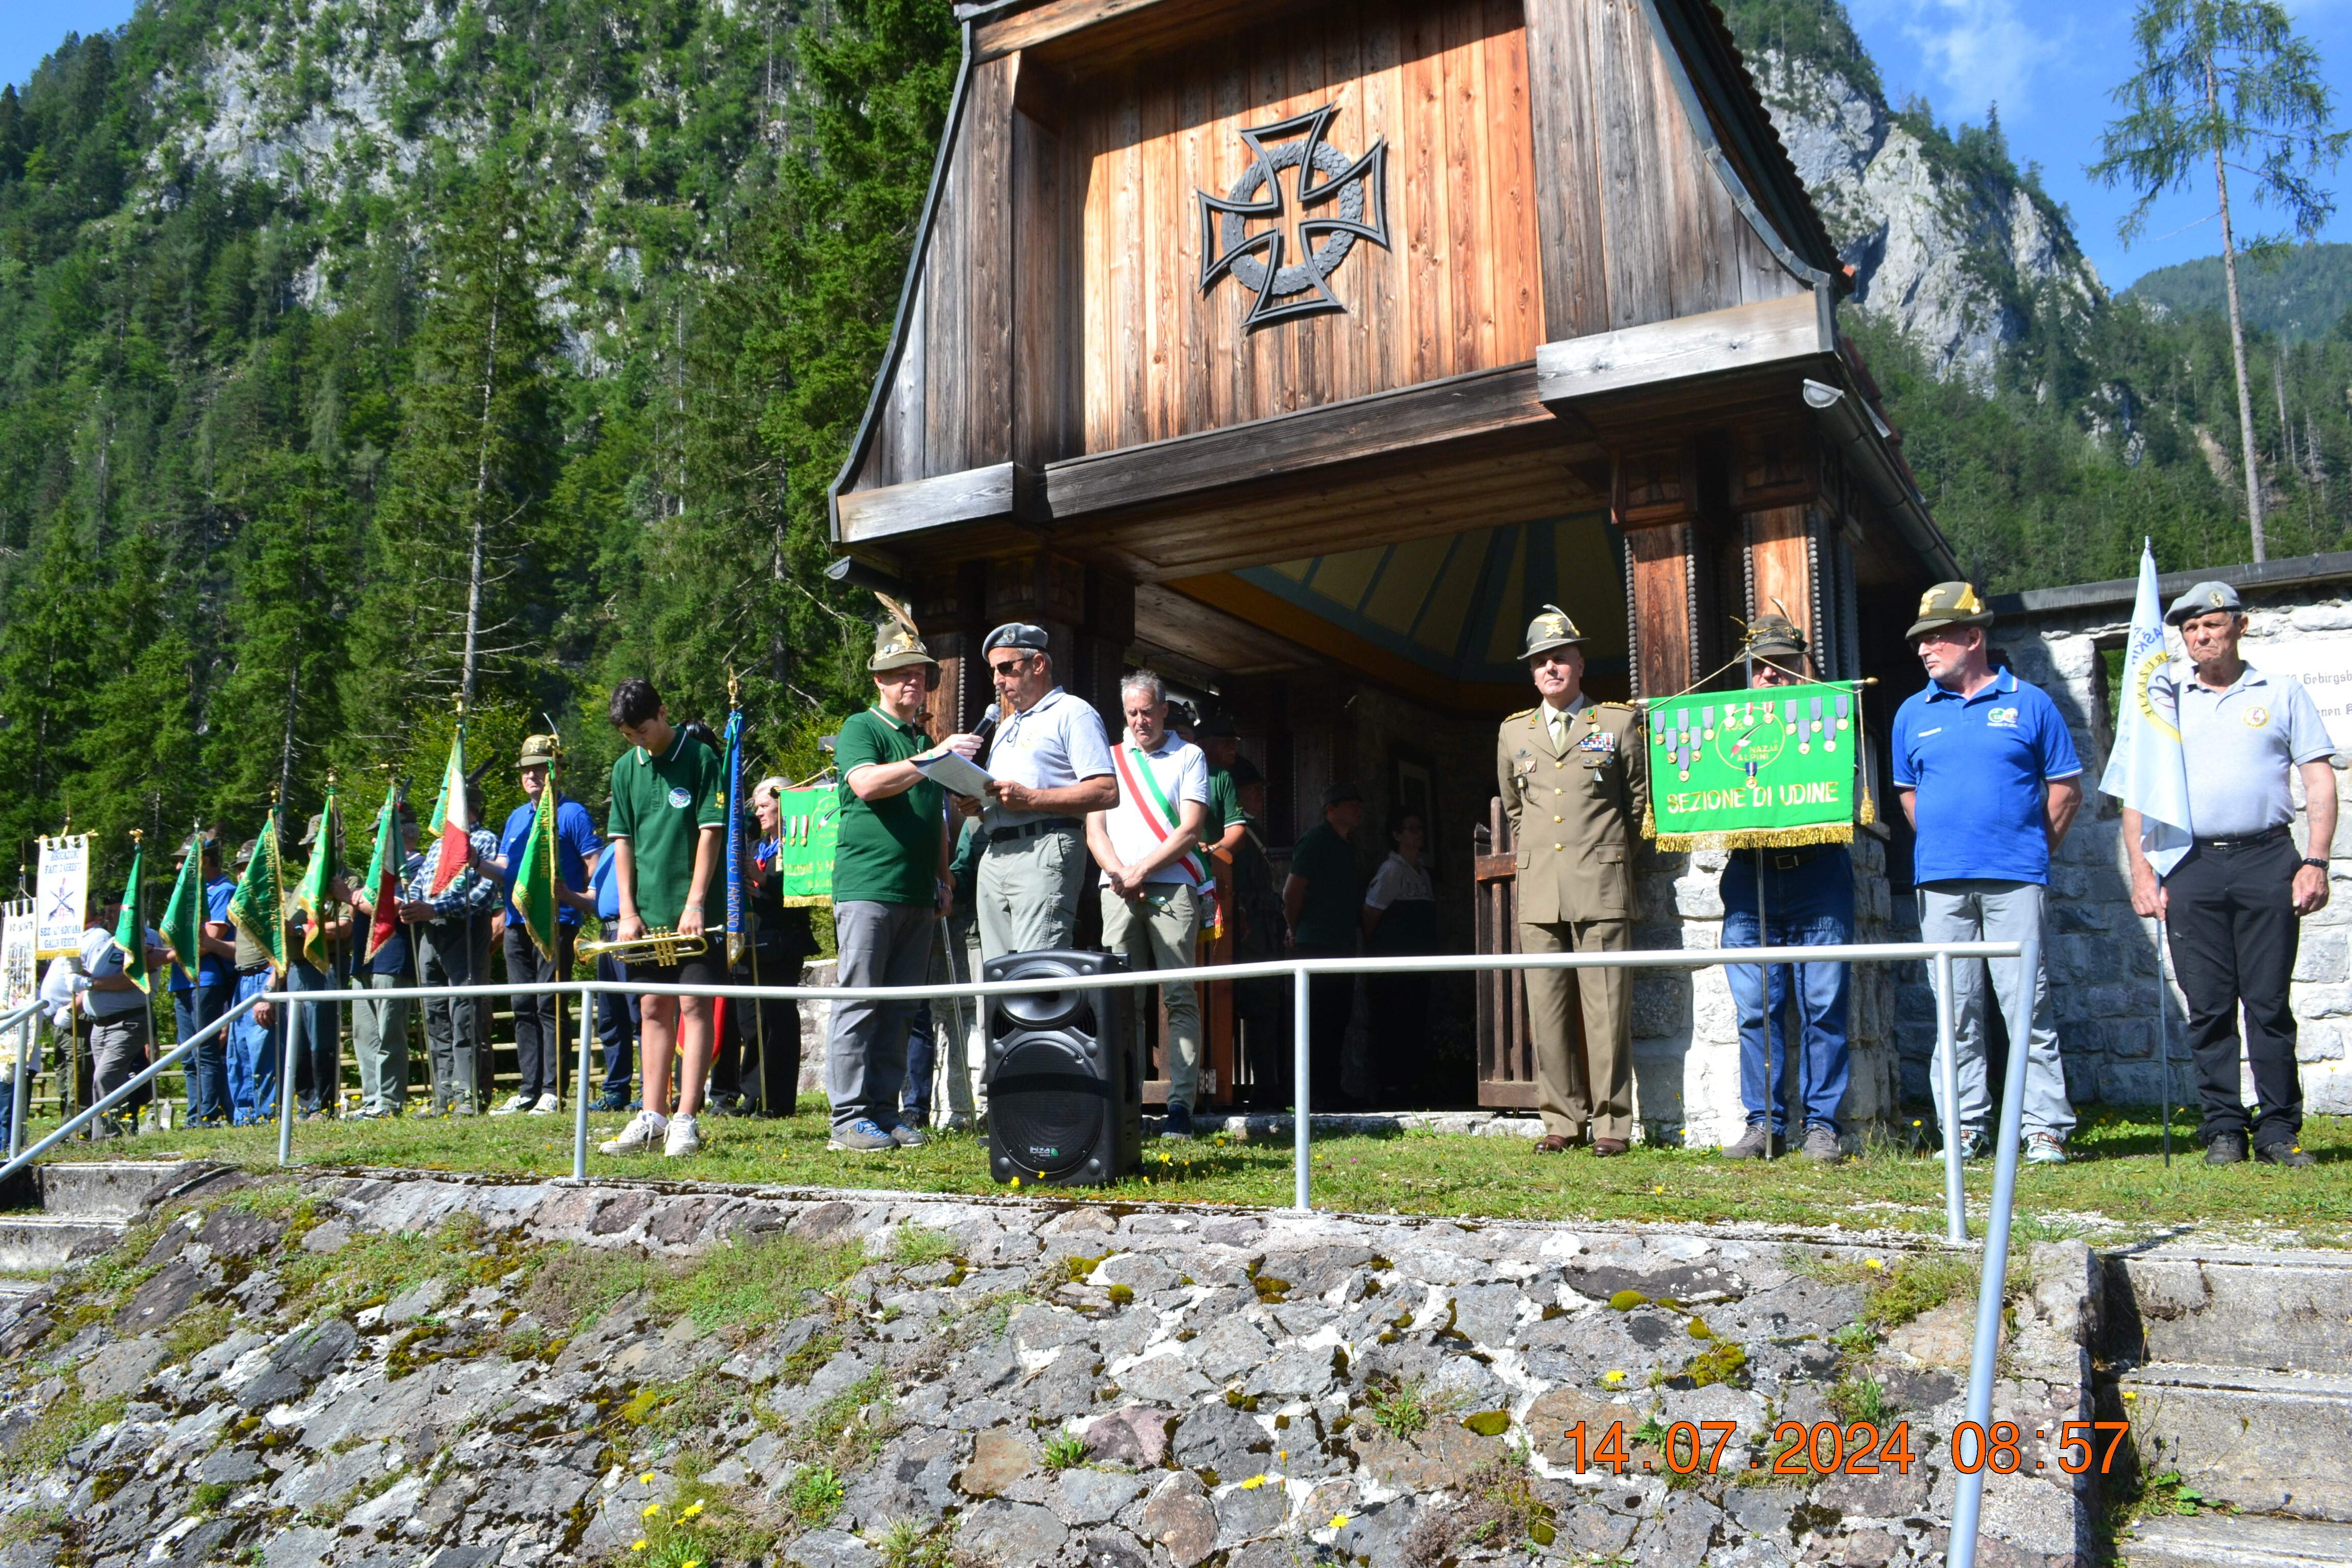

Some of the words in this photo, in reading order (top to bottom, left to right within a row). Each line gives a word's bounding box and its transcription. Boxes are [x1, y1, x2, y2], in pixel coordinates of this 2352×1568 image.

[1667, 788, 1746, 814] SEZIONE
[1752, 786, 1772, 807] DI
[1780, 782, 1839, 805] UDINE
[264, 831, 276, 870] SEZIONE
[540, 848, 549, 879] UDINE
[267, 871, 276, 883] DI
[267, 887, 279, 932] CIVIDALE
[727, 881, 741, 927] TARVISIO
